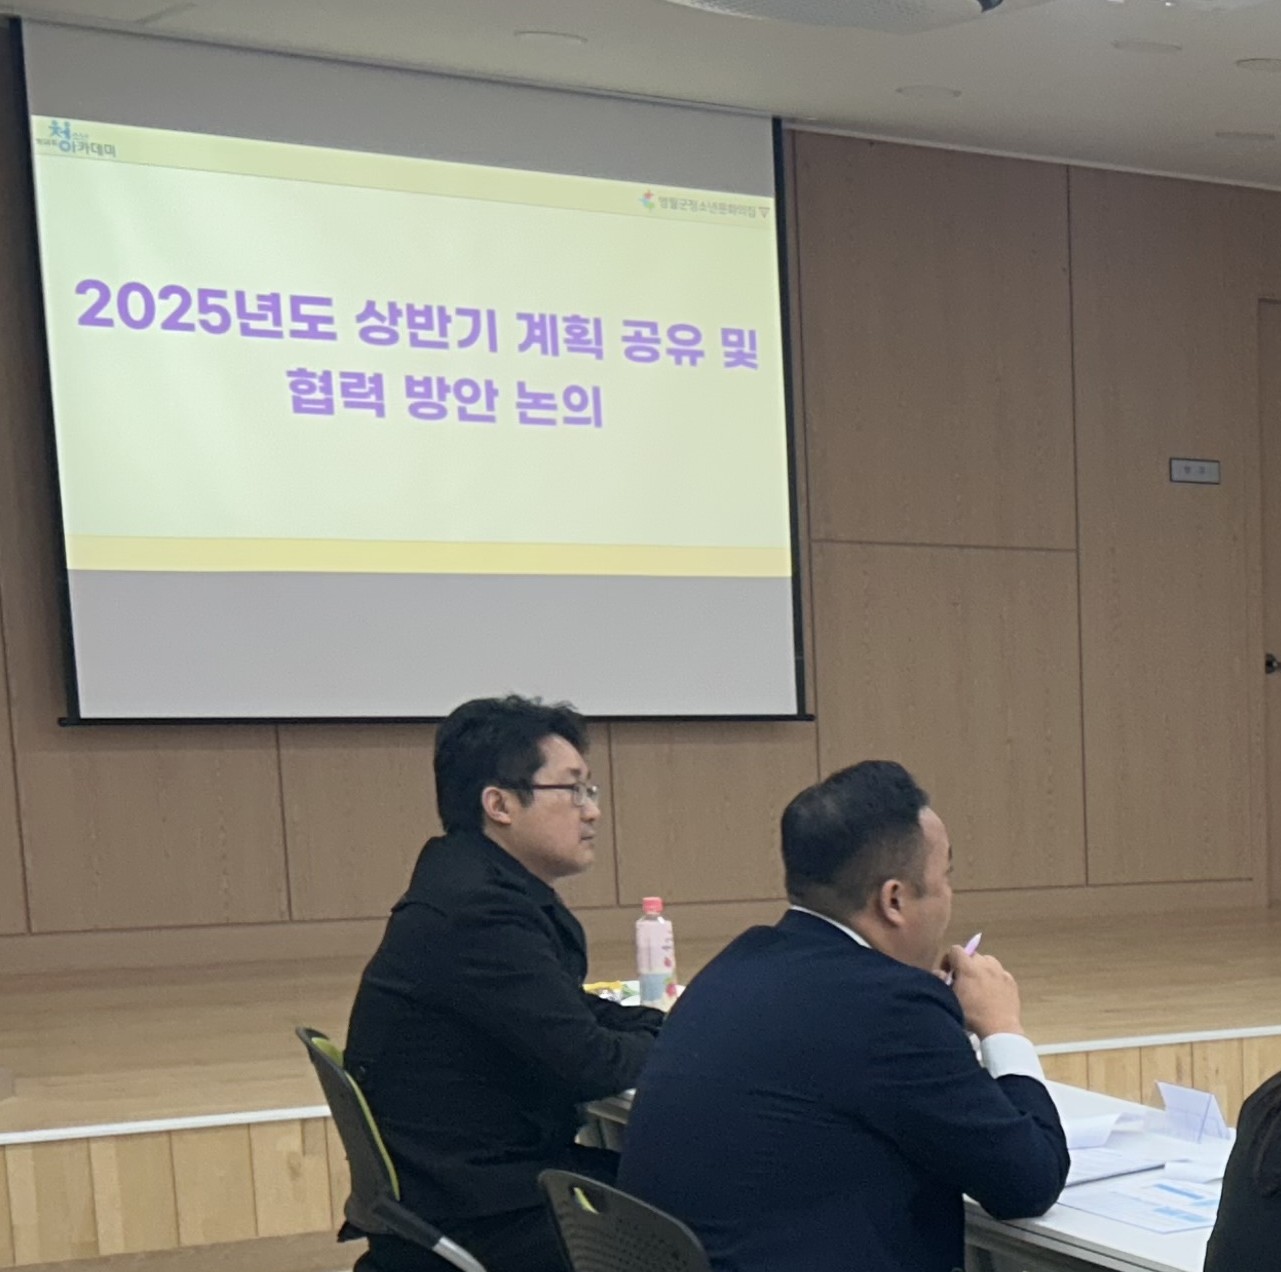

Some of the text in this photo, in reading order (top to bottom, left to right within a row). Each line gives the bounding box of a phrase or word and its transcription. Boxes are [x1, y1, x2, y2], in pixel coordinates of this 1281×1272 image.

[75, 279, 759, 370] 2025년도 상반기 계획 공유 및
[286, 367, 603, 428] 협력 방안 논의
